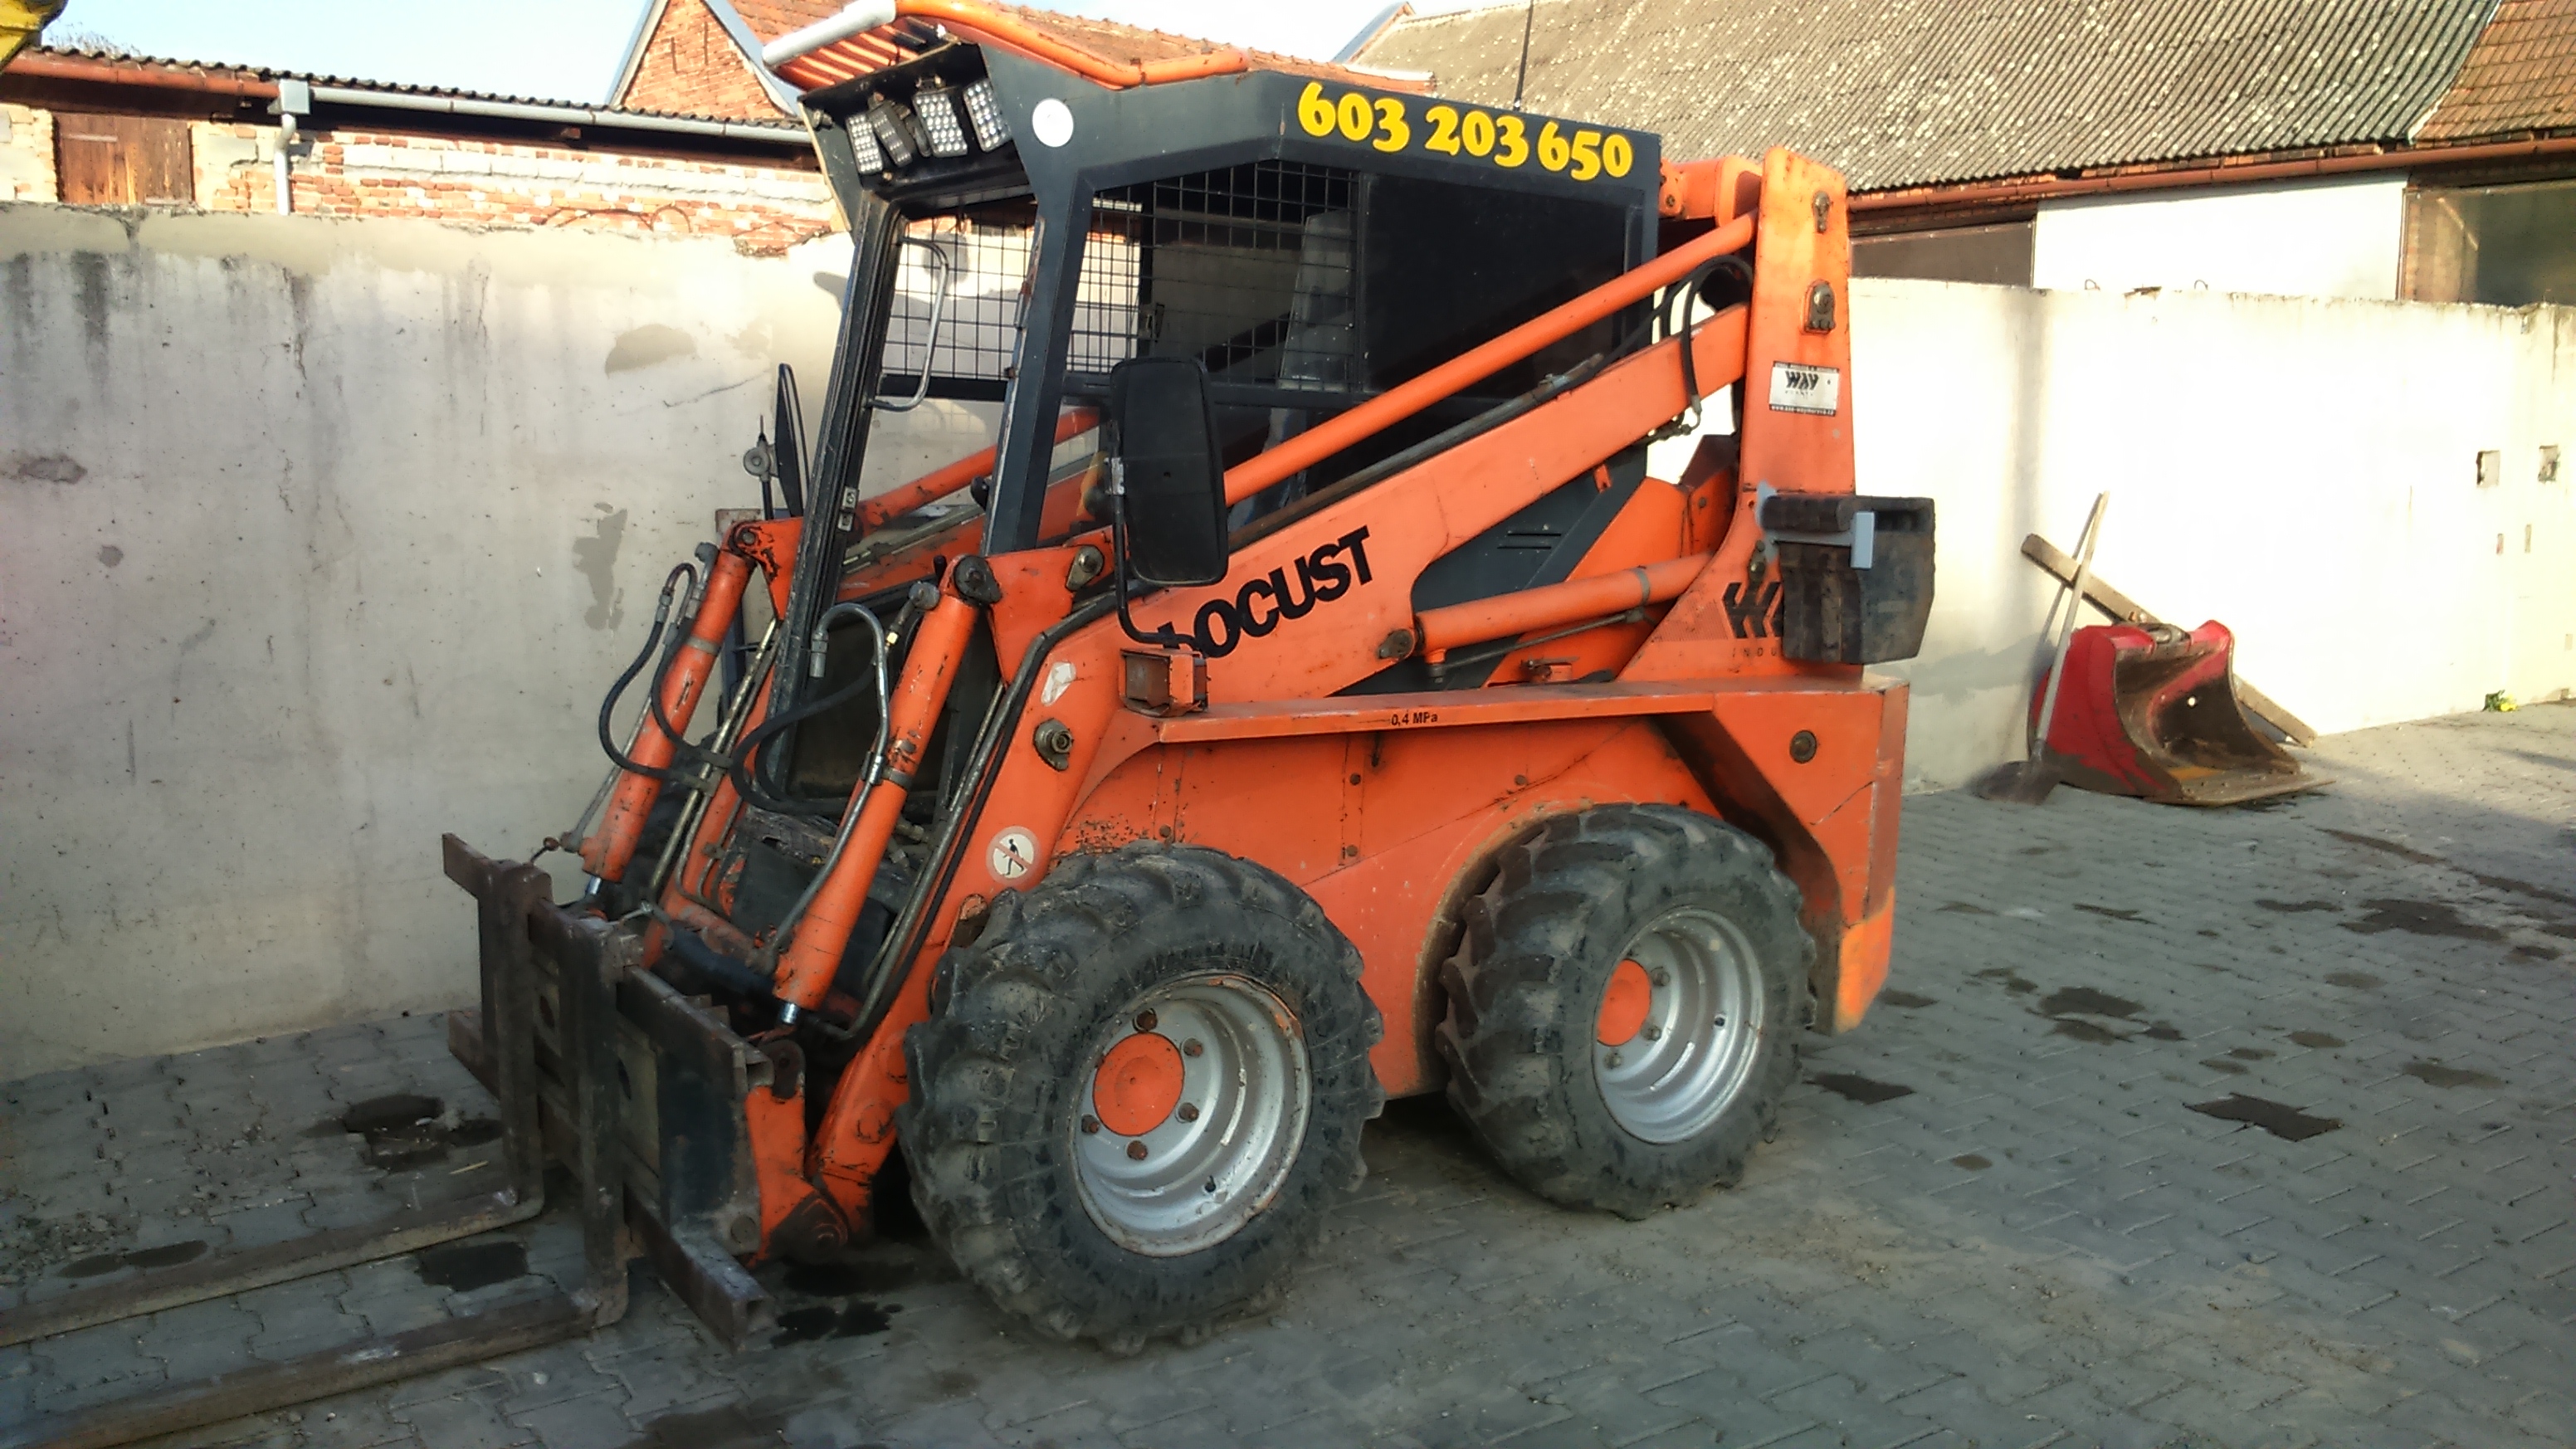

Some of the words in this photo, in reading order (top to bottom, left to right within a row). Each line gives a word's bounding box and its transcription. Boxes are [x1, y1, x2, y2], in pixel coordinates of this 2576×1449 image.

[1297, 81, 1411, 153] 603
[1424, 105, 1530, 168] 203
[1538, 121, 1633, 181] 650
[1785, 370, 1819, 391] WAY
[1391, 712, 1409, 727] 0,4
[1412, 711, 1438, 724] MPa
